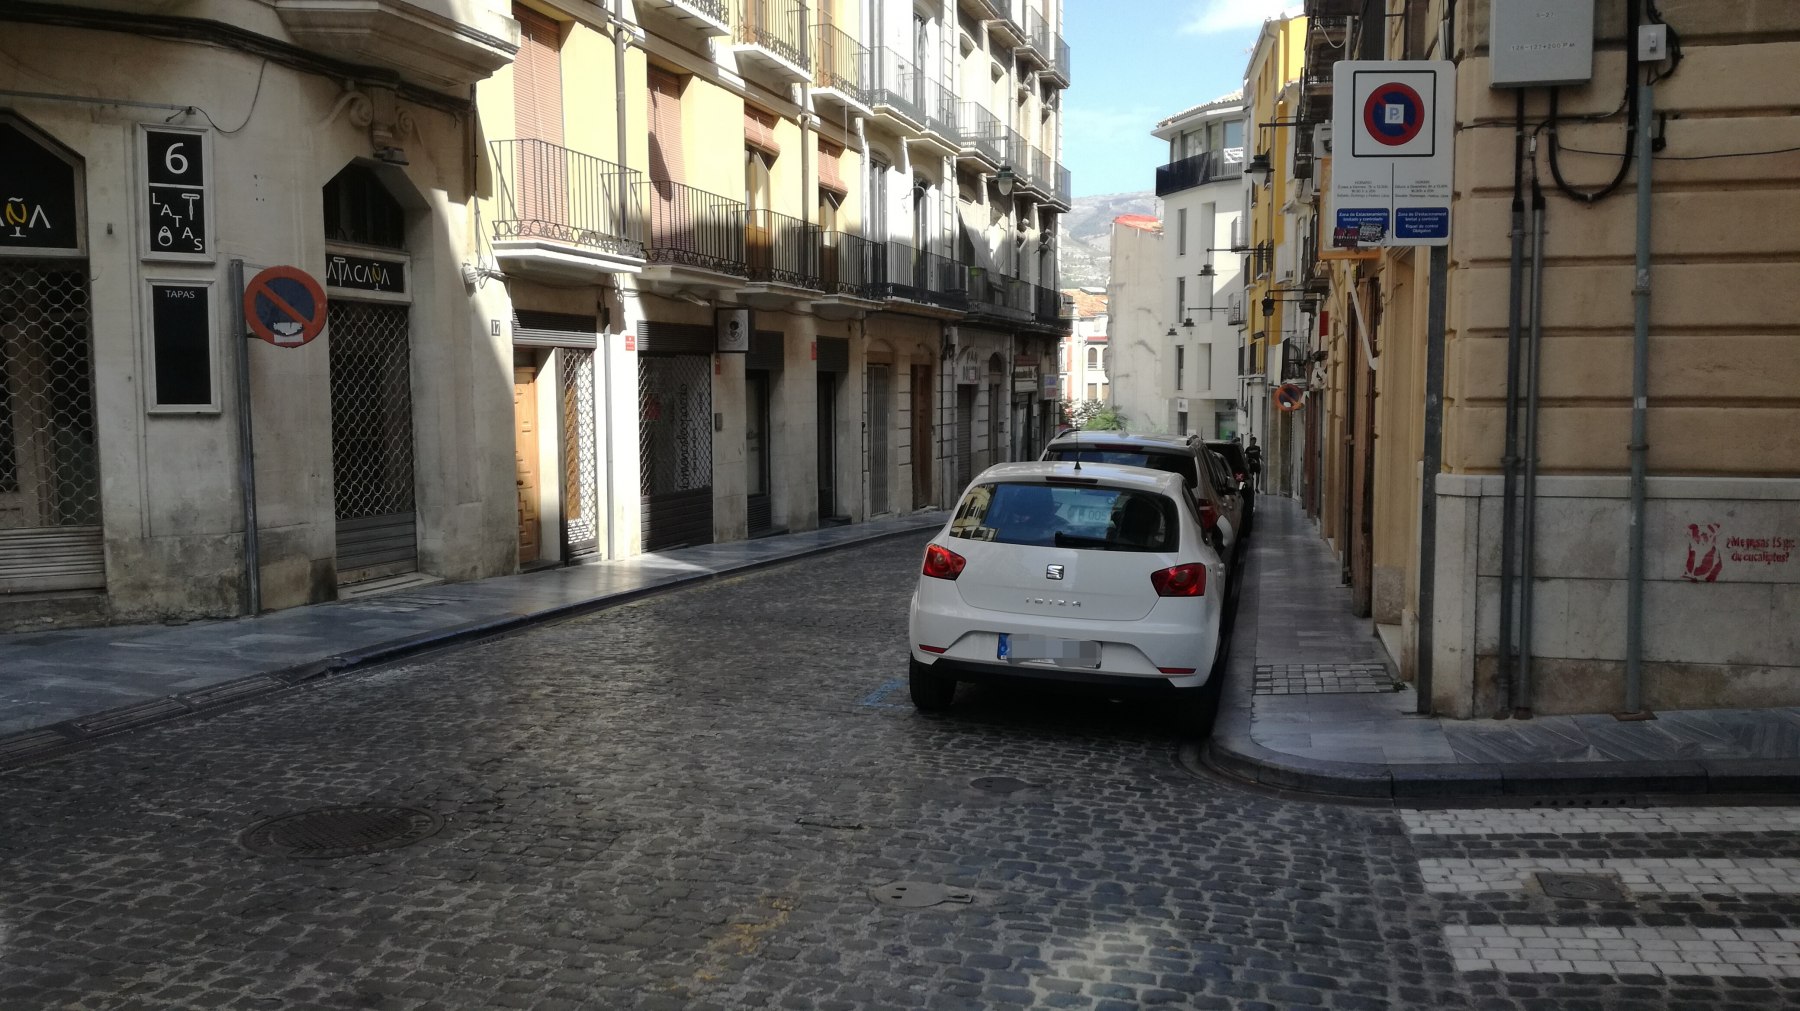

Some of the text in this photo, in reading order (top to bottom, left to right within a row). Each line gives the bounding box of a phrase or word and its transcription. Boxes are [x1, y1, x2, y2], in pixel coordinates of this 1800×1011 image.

[165, 142, 188, 174] 6
[0, 197, 51, 237] ÑA
[152, 192, 203, 251] LATAS
[326, 256, 391, 291] ATACAÑA
[165, 289, 195, 299] TAPAS
[492, 320, 500, 335] 17
[1731, 551, 1742, 562] de
